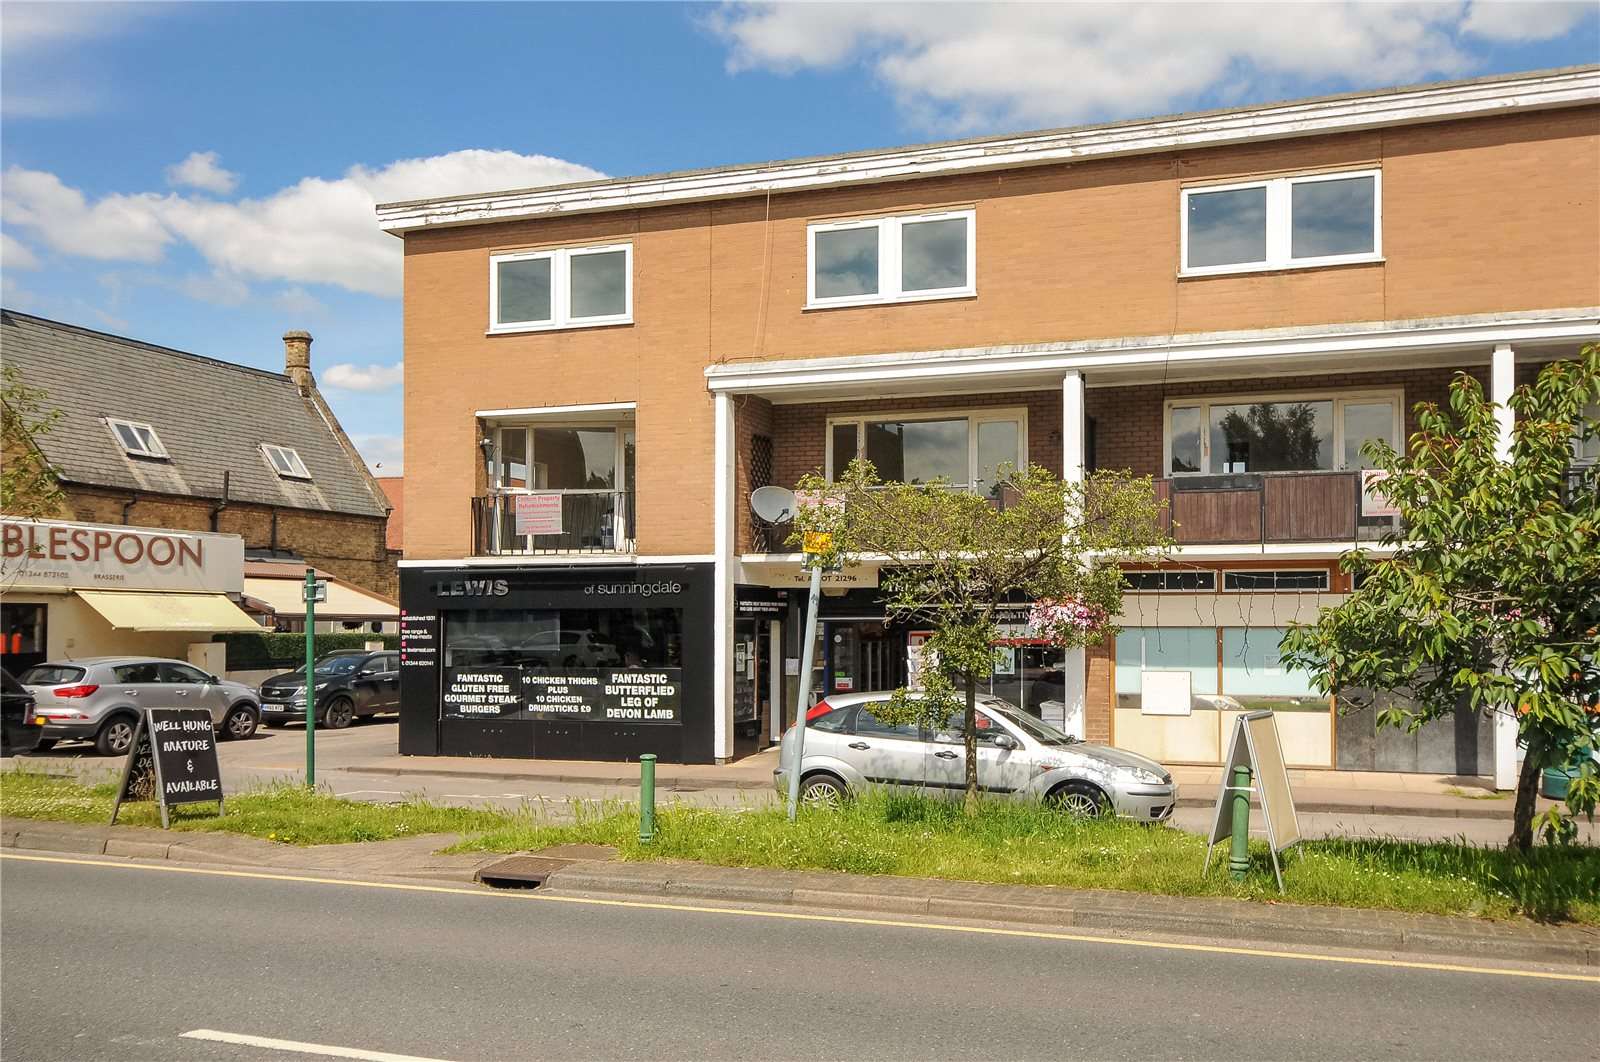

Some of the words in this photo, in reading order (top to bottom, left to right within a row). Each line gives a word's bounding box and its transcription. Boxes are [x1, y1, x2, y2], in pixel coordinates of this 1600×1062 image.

[93, 573, 125, 581] BRASSERIE
[437, 579, 509, 596] LEWIS
[584, 585, 595, 594] of
[597, 581, 682, 597] sunningdale
[457, 674, 504, 683] FANTASTIC
[522, 676, 531, 685] 10
[532, 676, 567, 685] CHICKEN
[568, 677, 598, 686] THIGHS
[611, 673, 668, 684] FANTASTIC
[451, 684, 485, 693] GLUTEN
[486, 684, 510, 693] FREE
[547, 685, 569, 694] PLUS
[605, 685, 675, 696] BUTTERFLIED
[444, 694, 486, 703] GOURMET
[488, 695, 517, 704] STEAK
[536, 695, 544, 703] 10
[546, 695, 582, 704] CHICKEN
[621, 697, 642, 707] LEG
[644, 697, 659, 708] OF
[460, 704, 500, 714] BURGERS
[528, 704, 579, 713] DRUMSTICKS
[580, 704, 592, 713] £9
[606, 708, 642, 719] DEVON
[644, 709, 674, 720] LAMB
[153, 721, 181, 733] WELL
[183, 720, 211, 732] HUNG
[163, 740, 210, 752] MATURE
[187, 760, 194, 773] &
[166, 779, 218, 794] AVAILABLE
